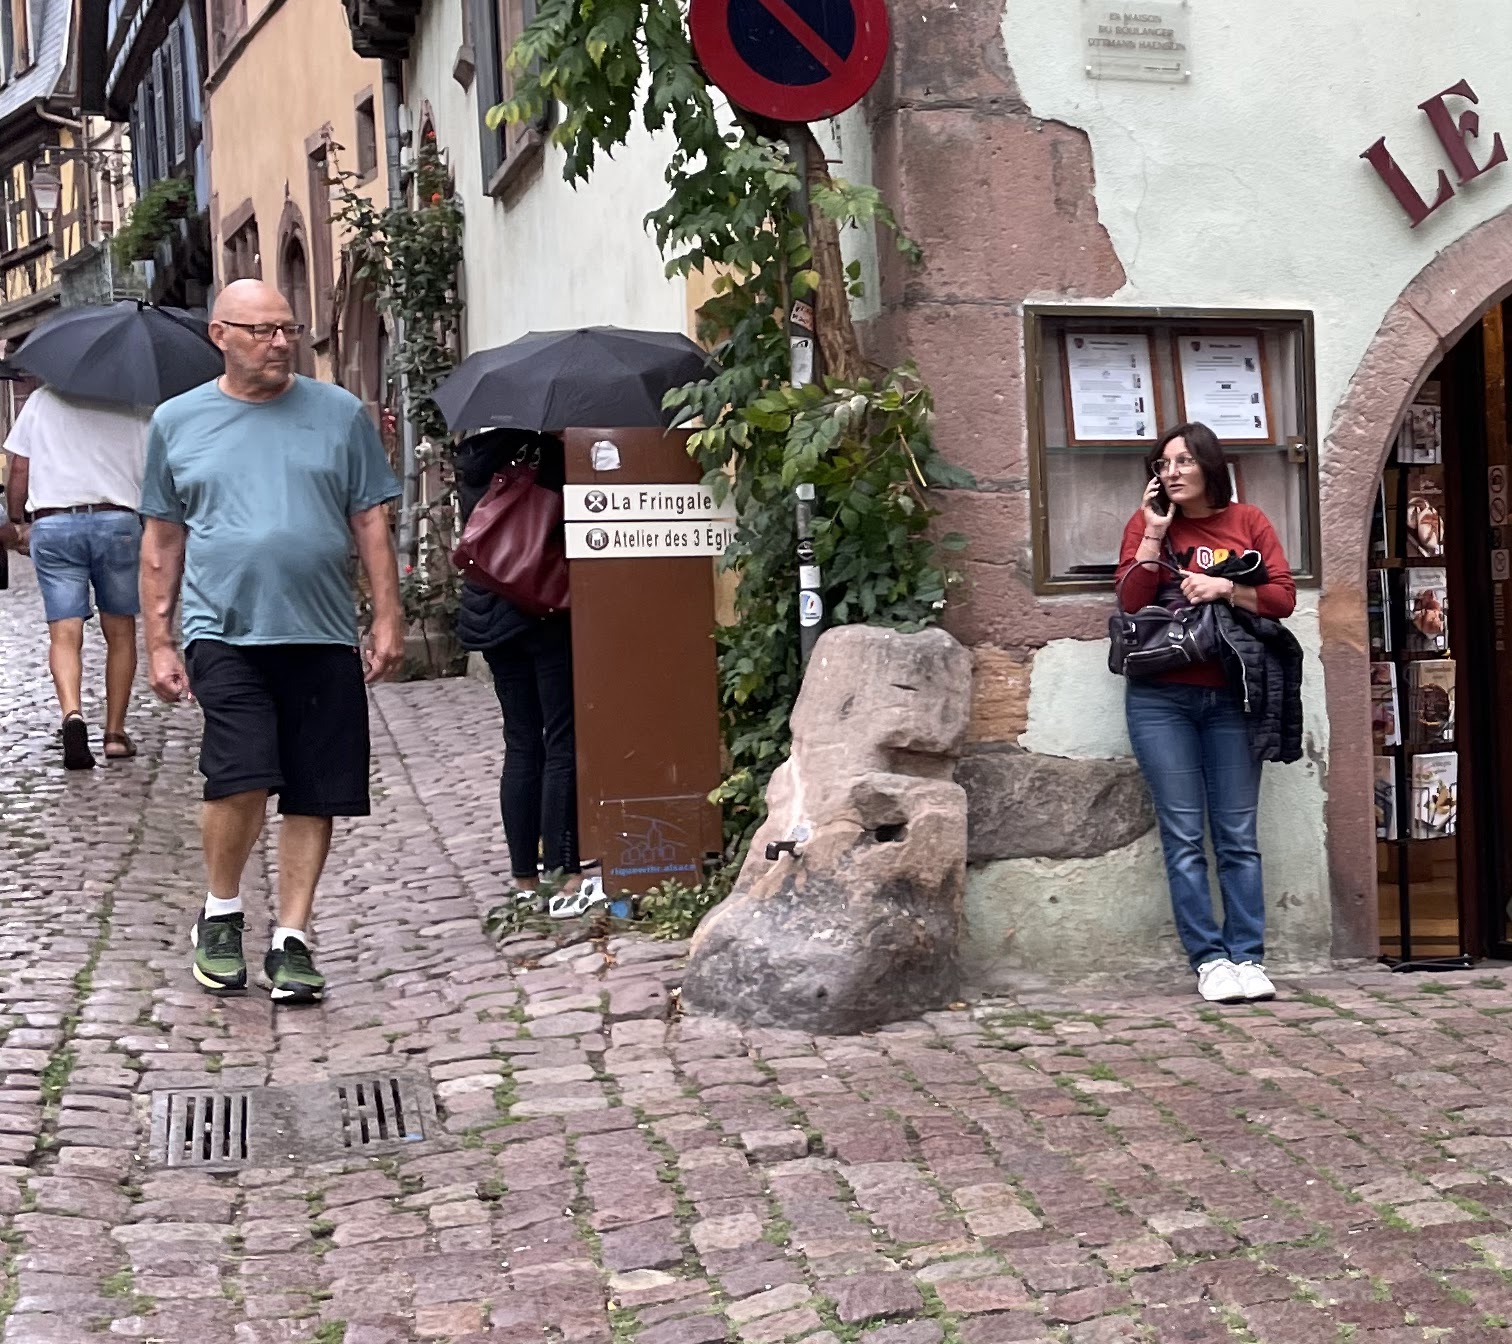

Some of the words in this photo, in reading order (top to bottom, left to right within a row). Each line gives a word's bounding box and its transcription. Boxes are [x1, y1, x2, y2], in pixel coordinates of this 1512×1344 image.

[1359, 78, 1509, 229] LE
[611, 493, 631, 510] La
[639, 492, 712, 514] Fringale
[613, 529, 659, 548] Atelier
[665, 529, 688, 547] des
[693, 528, 700, 546] 3
